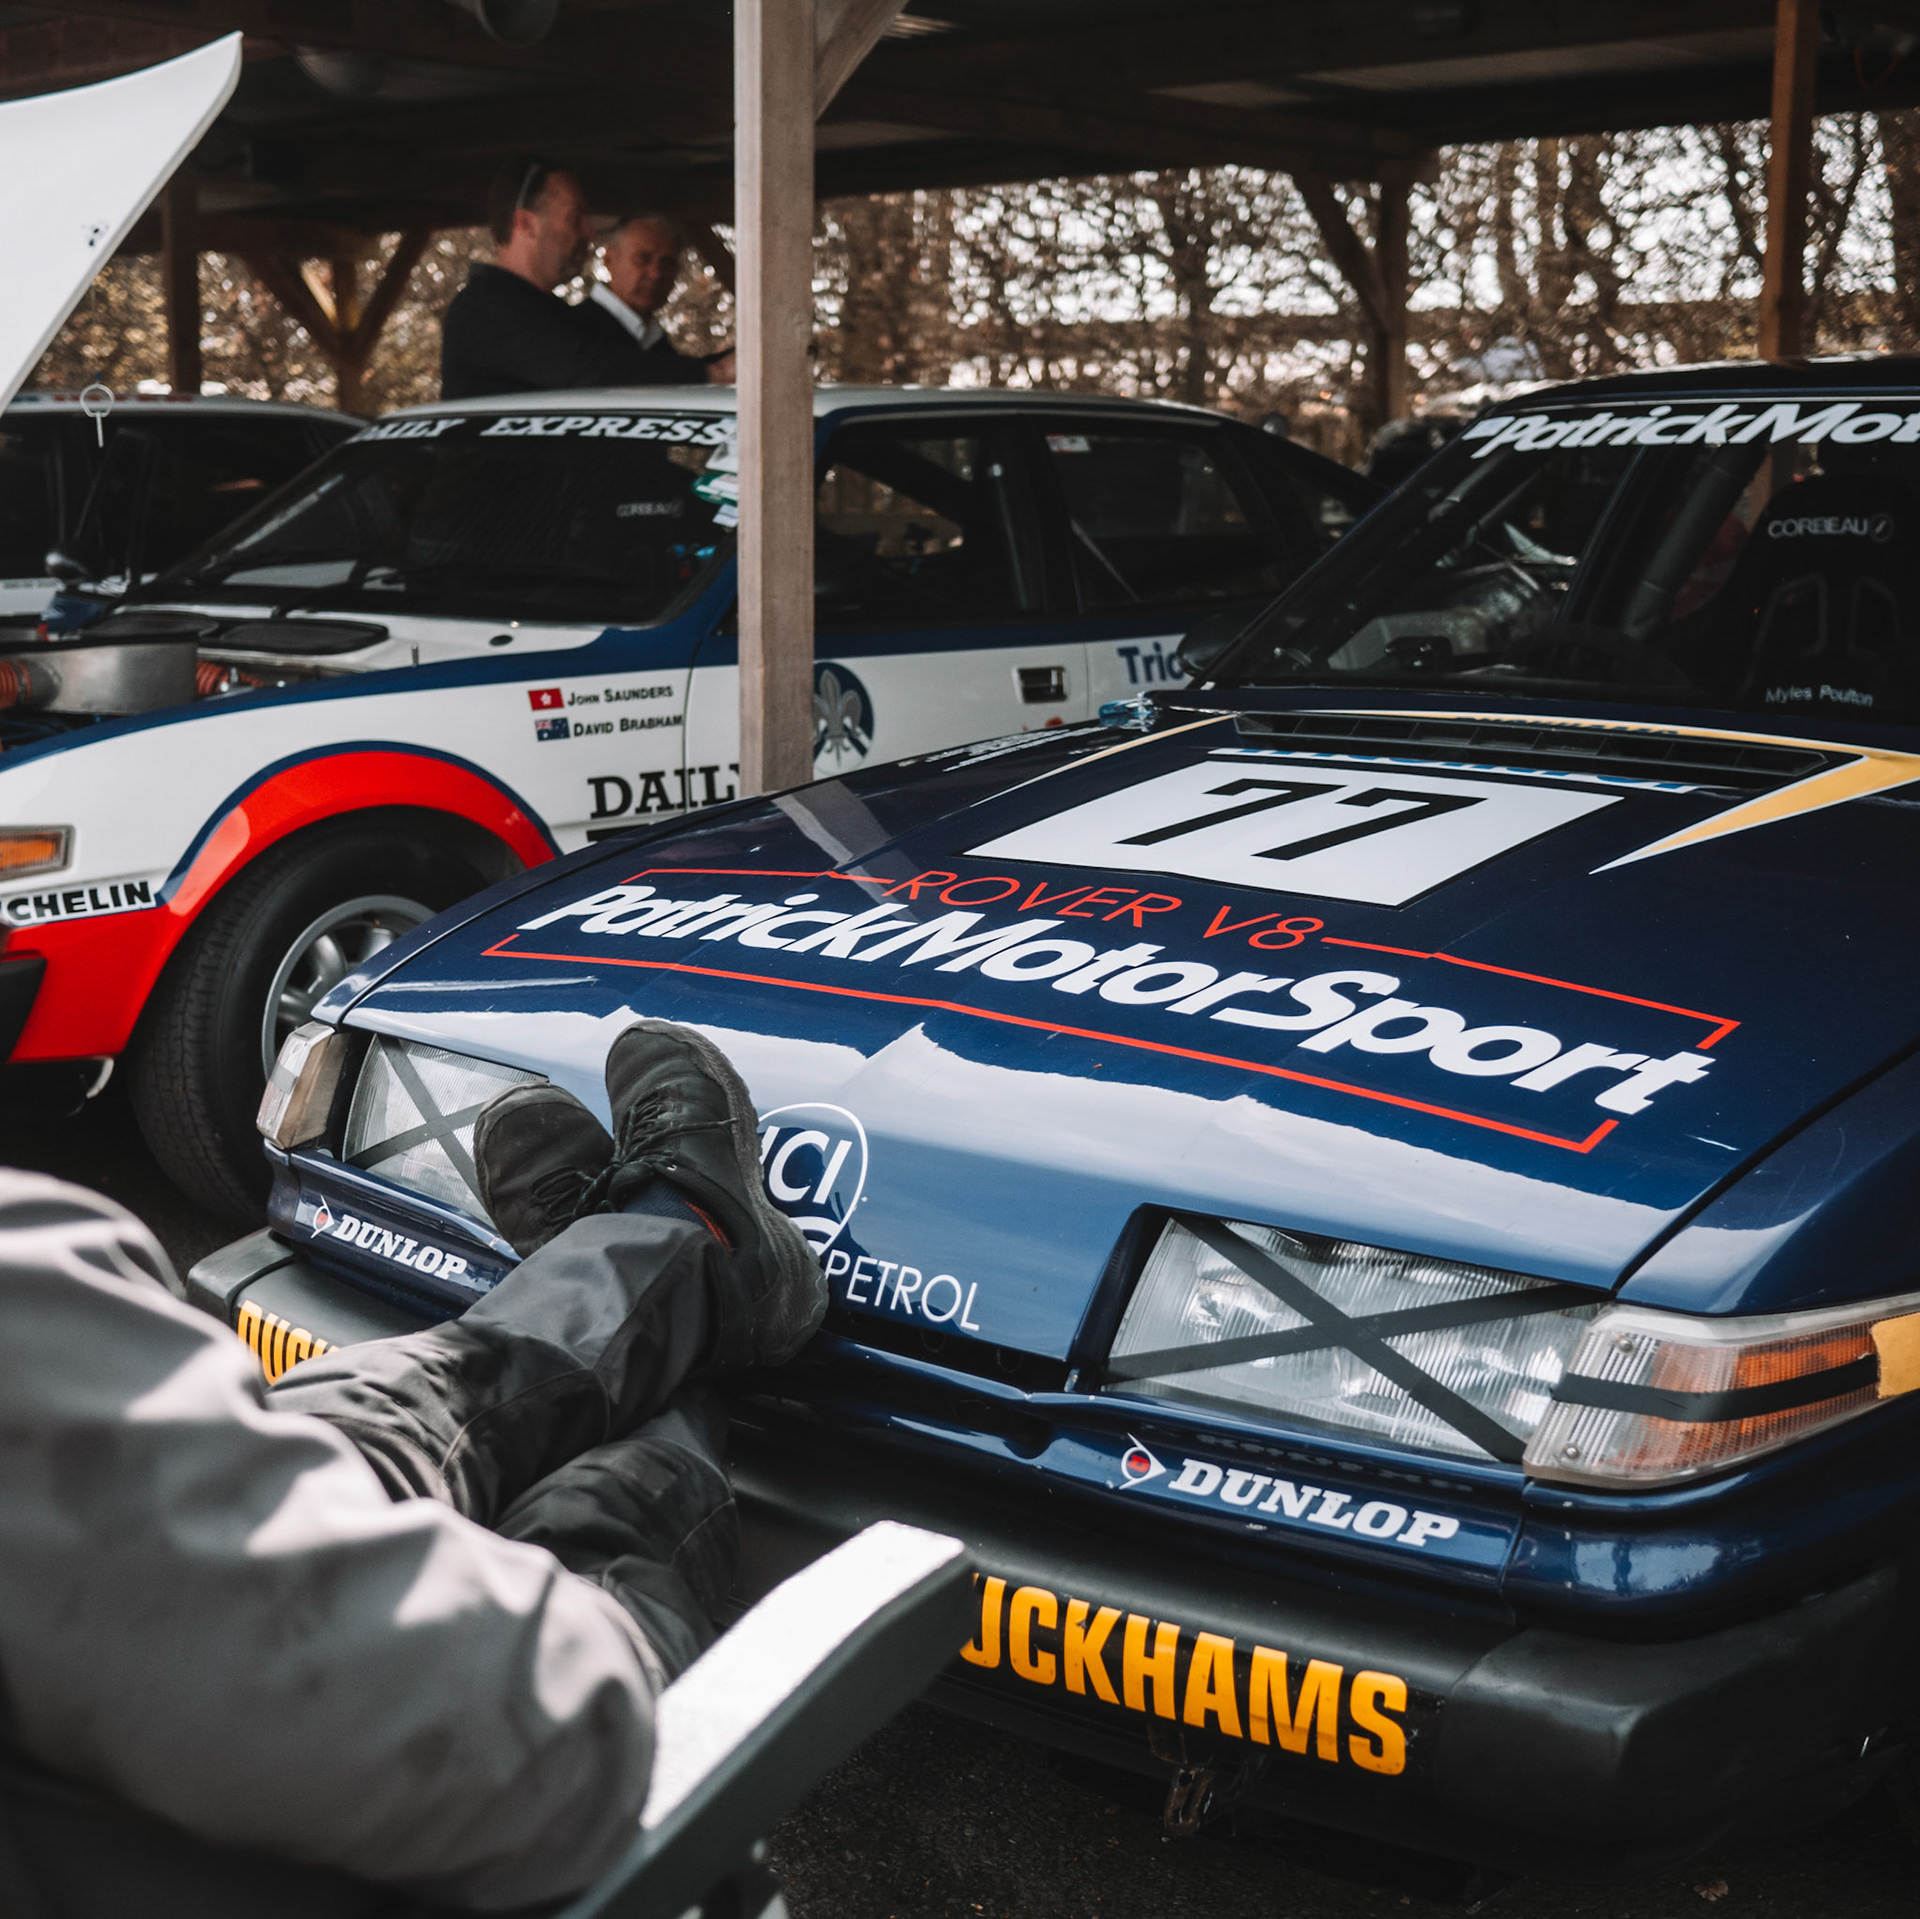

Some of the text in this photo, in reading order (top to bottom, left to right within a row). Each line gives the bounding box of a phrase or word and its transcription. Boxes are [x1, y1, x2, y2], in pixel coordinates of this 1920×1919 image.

[480, 416, 733, 446] EXPRESS
[1768, 517, 1869, 539] CORBEAU
[567, 685, 673, 707] JOHN SAUNDERS
[1765, 684, 1874, 708] Myles Poulton
[573, 714, 684, 738] DAVID BRABHAM
[587, 763, 740, 820] DAIL
[1113, 778, 1489, 861] 77
[0, 881, 151, 921] CHELIN
[892, 870, 1324, 950] ROVER V8
[516, 885, 1716, 1116] PatrickMotorSport
[331, 1214, 468, 1281] DUNLOP
[825, 1248, 980, 1332] PETROL
[1168, 1457, 1460, 1547] DUNLOP
